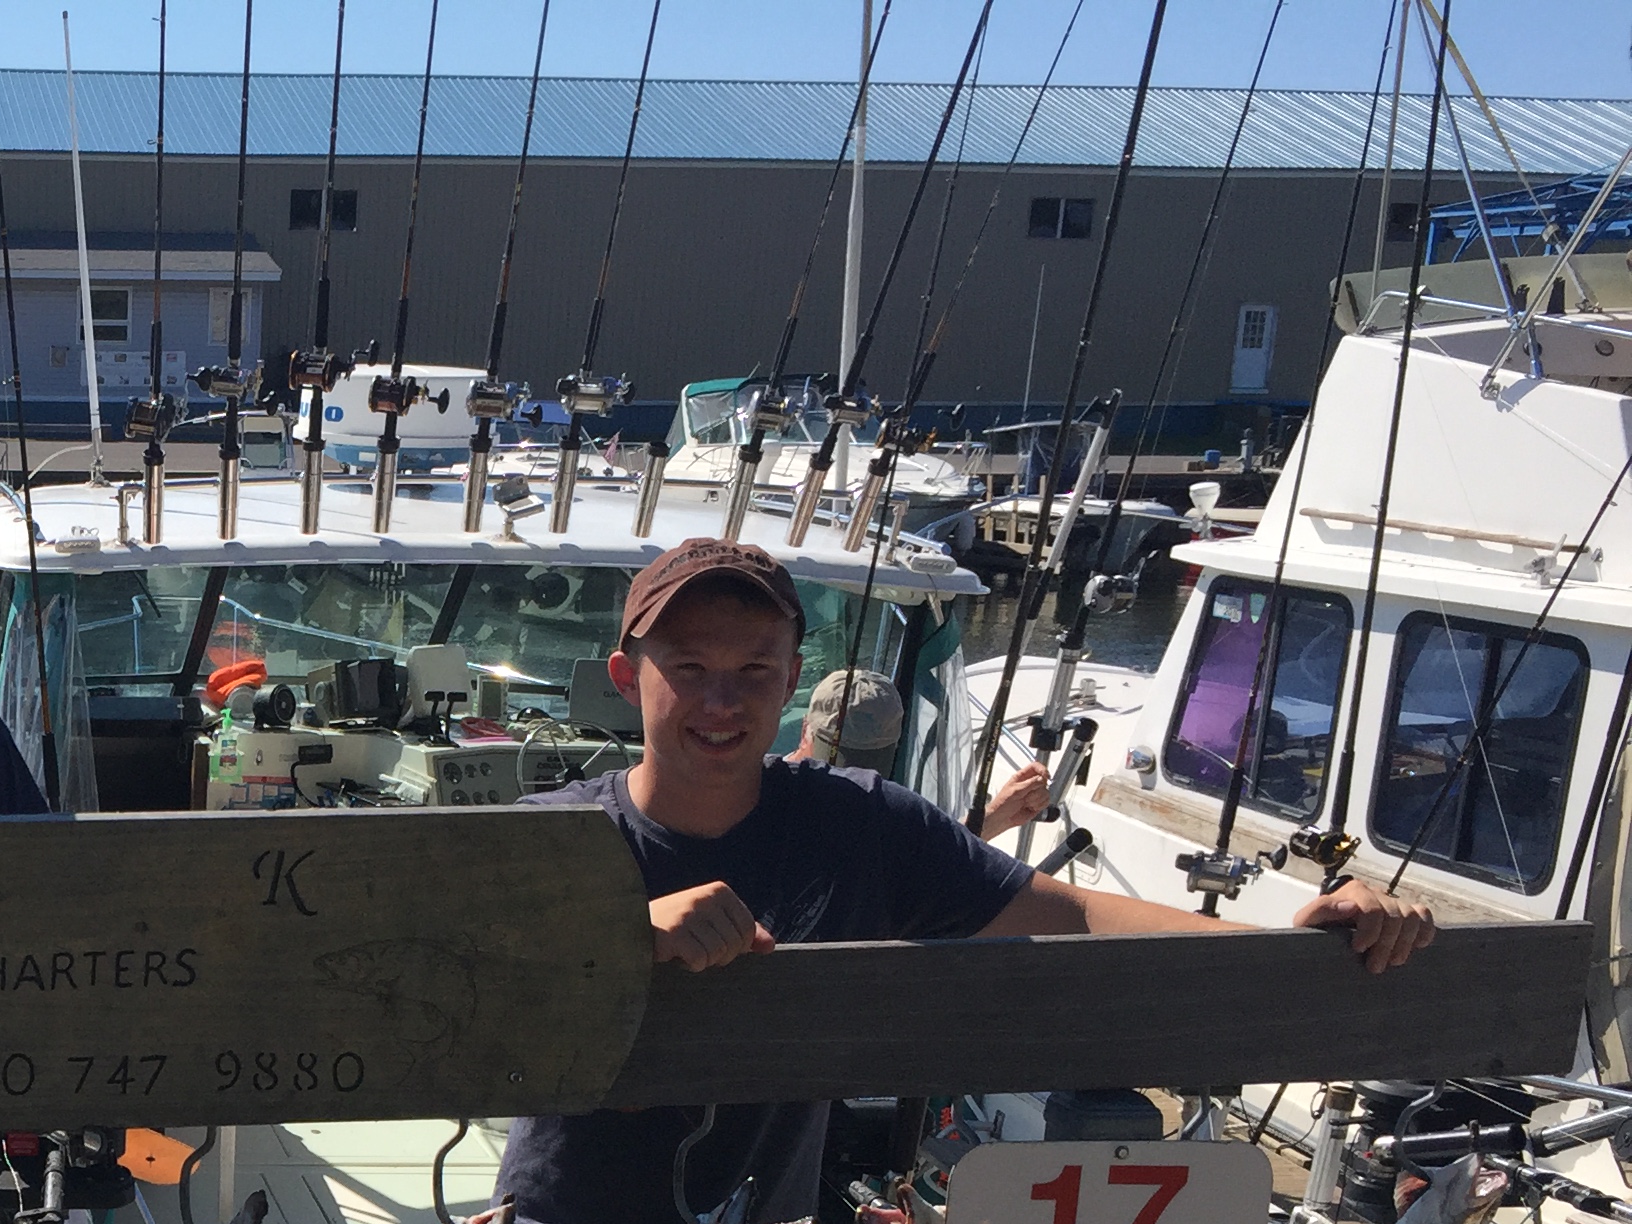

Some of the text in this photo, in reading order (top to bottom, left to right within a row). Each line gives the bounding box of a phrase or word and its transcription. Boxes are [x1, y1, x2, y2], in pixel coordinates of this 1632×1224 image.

[253, 849, 317, 916] K
[68, 1055, 168, 1095] 747
[215, 1049, 365, 1093] 9880
